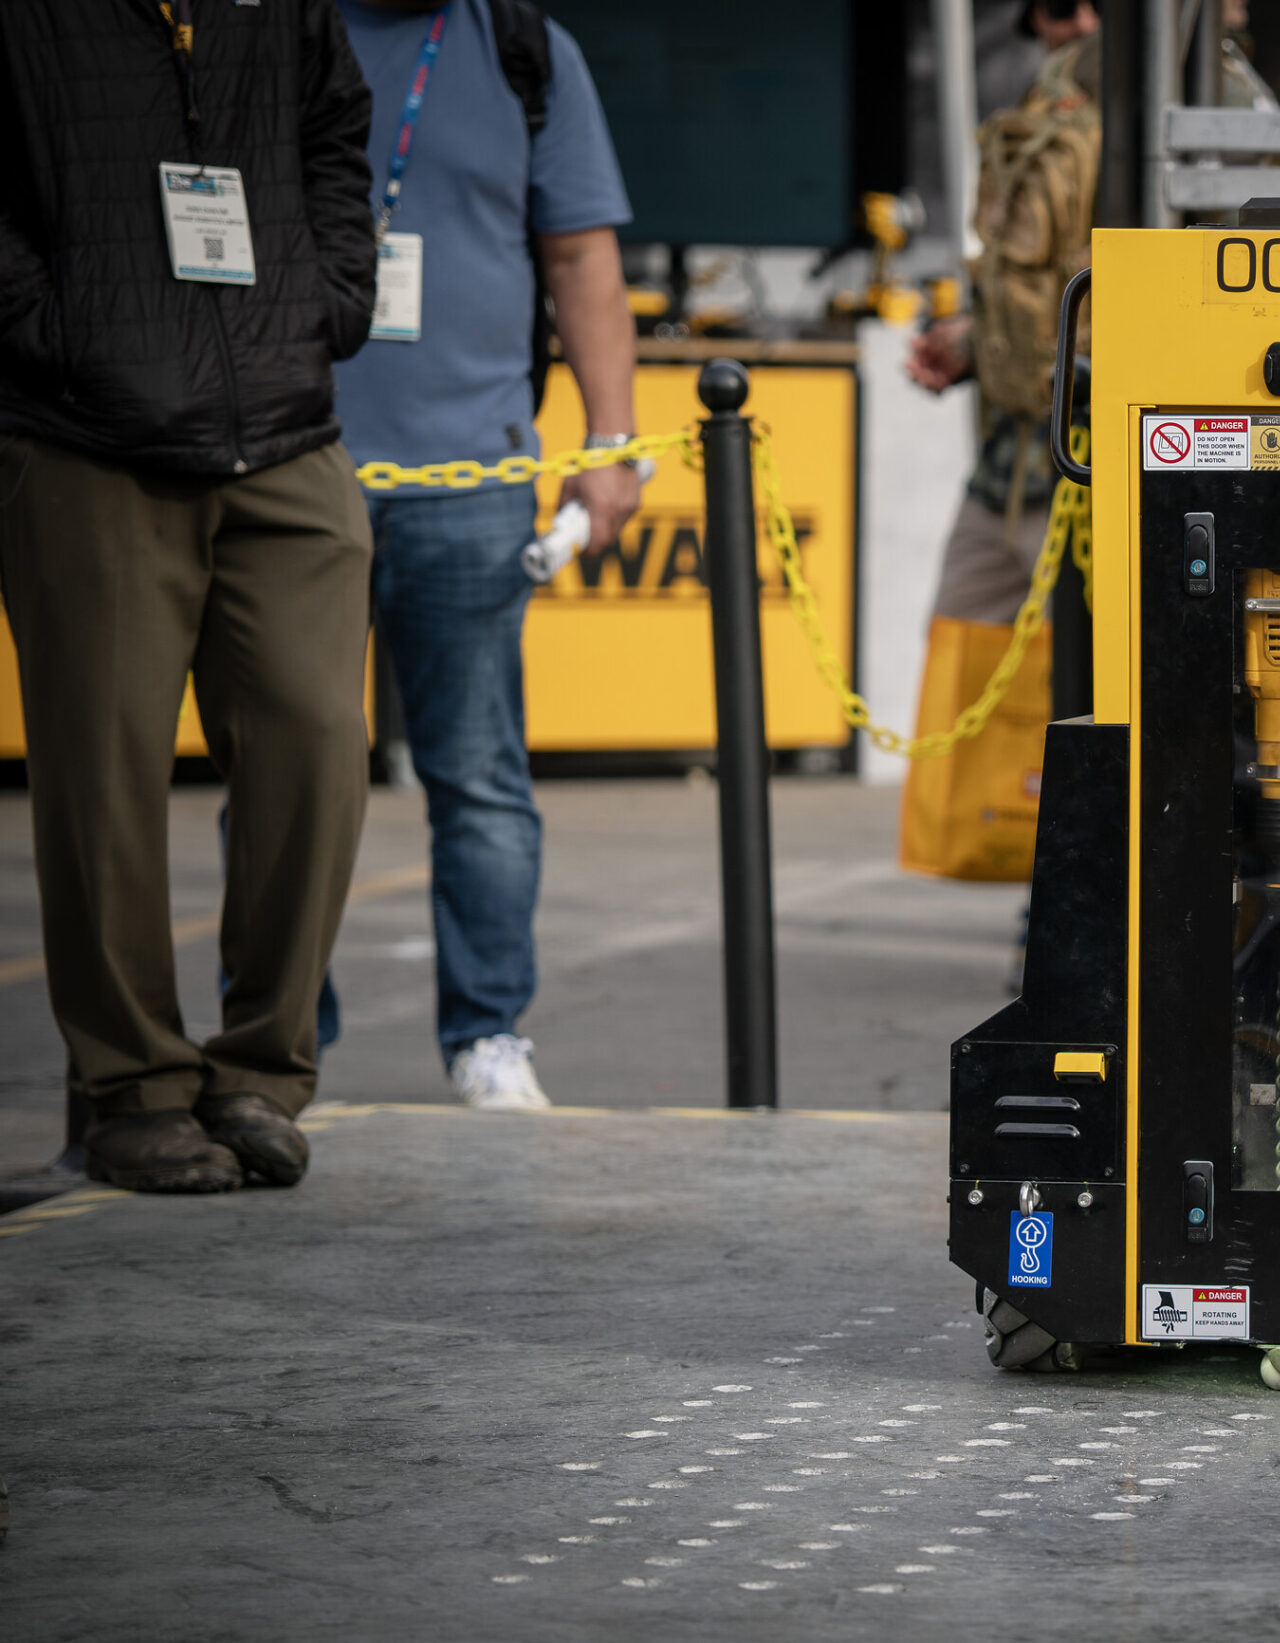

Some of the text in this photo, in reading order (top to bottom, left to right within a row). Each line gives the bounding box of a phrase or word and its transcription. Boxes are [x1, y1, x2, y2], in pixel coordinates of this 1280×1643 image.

[1210, 421, 1244, 430] DANGER
[1011, 1275, 1048, 1284] HOOKING
[1208, 1291, 1243, 1300] DANGER
[1202, 1311, 1237, 1319] ROTATING
